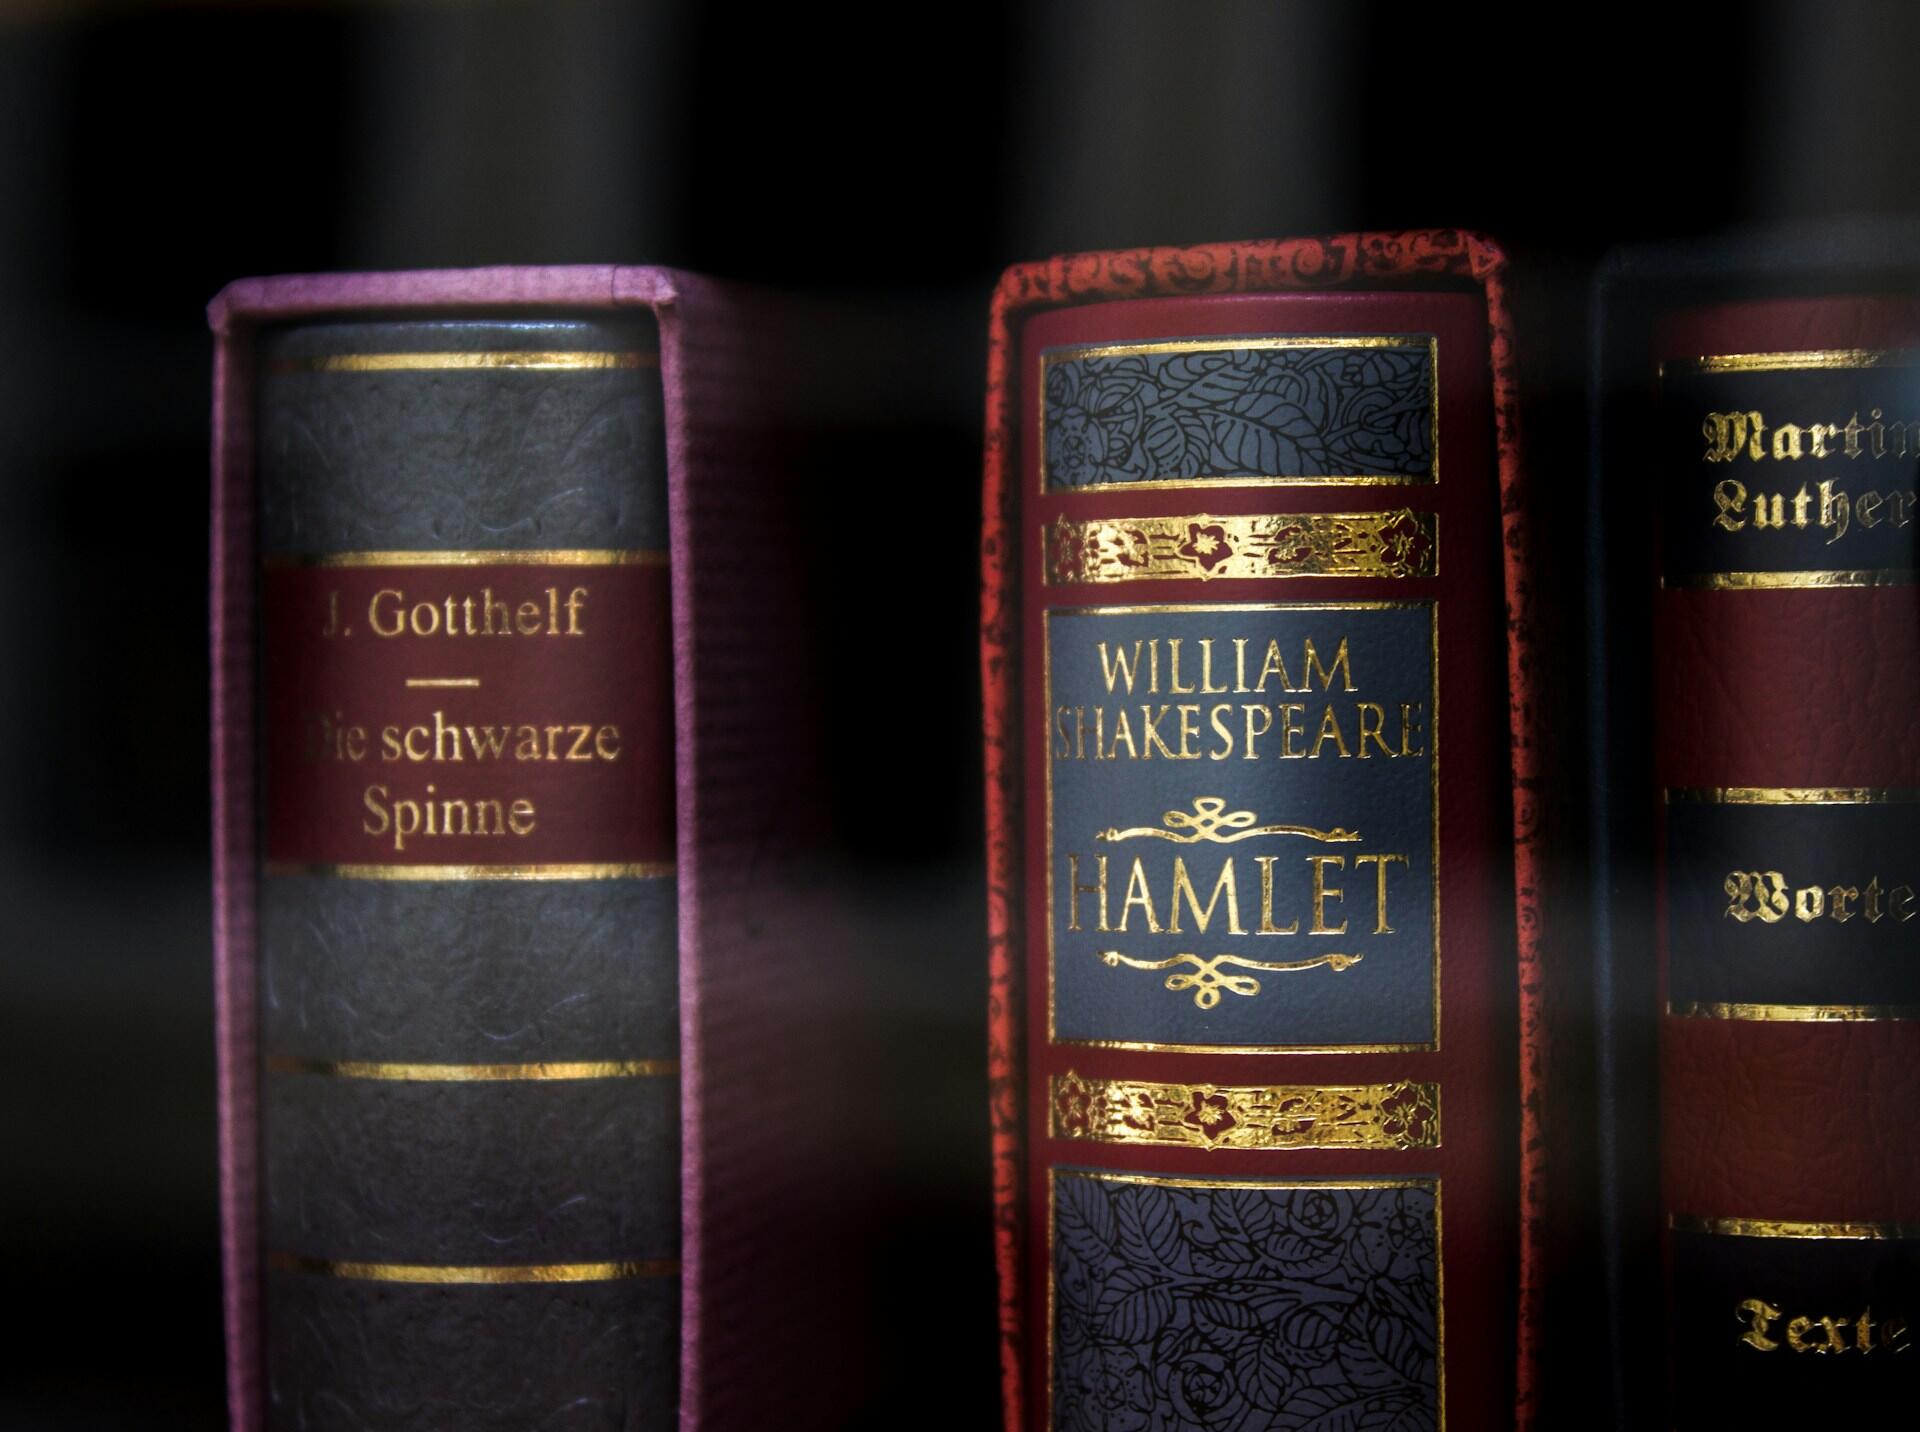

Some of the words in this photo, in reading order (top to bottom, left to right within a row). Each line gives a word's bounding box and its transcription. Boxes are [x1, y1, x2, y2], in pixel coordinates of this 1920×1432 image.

[1712, 477, 1918, 545] Luther
[323, 590, 351, 637] J.
[369, 587, 590, 637] Gotthelf
[1097, 635, 1359, 695] WILLIAM
[381, 710, 621, 762] schwarze
[1056, 702, 1424, 761] SHAKESPEARE
[363, 784, 537, 850] Spinne
[1067, 853, 1410, 936] HAMLET
[1723, 870, 1917, 924] Worte
[1735, 1297, 1912, 1355] Texte
